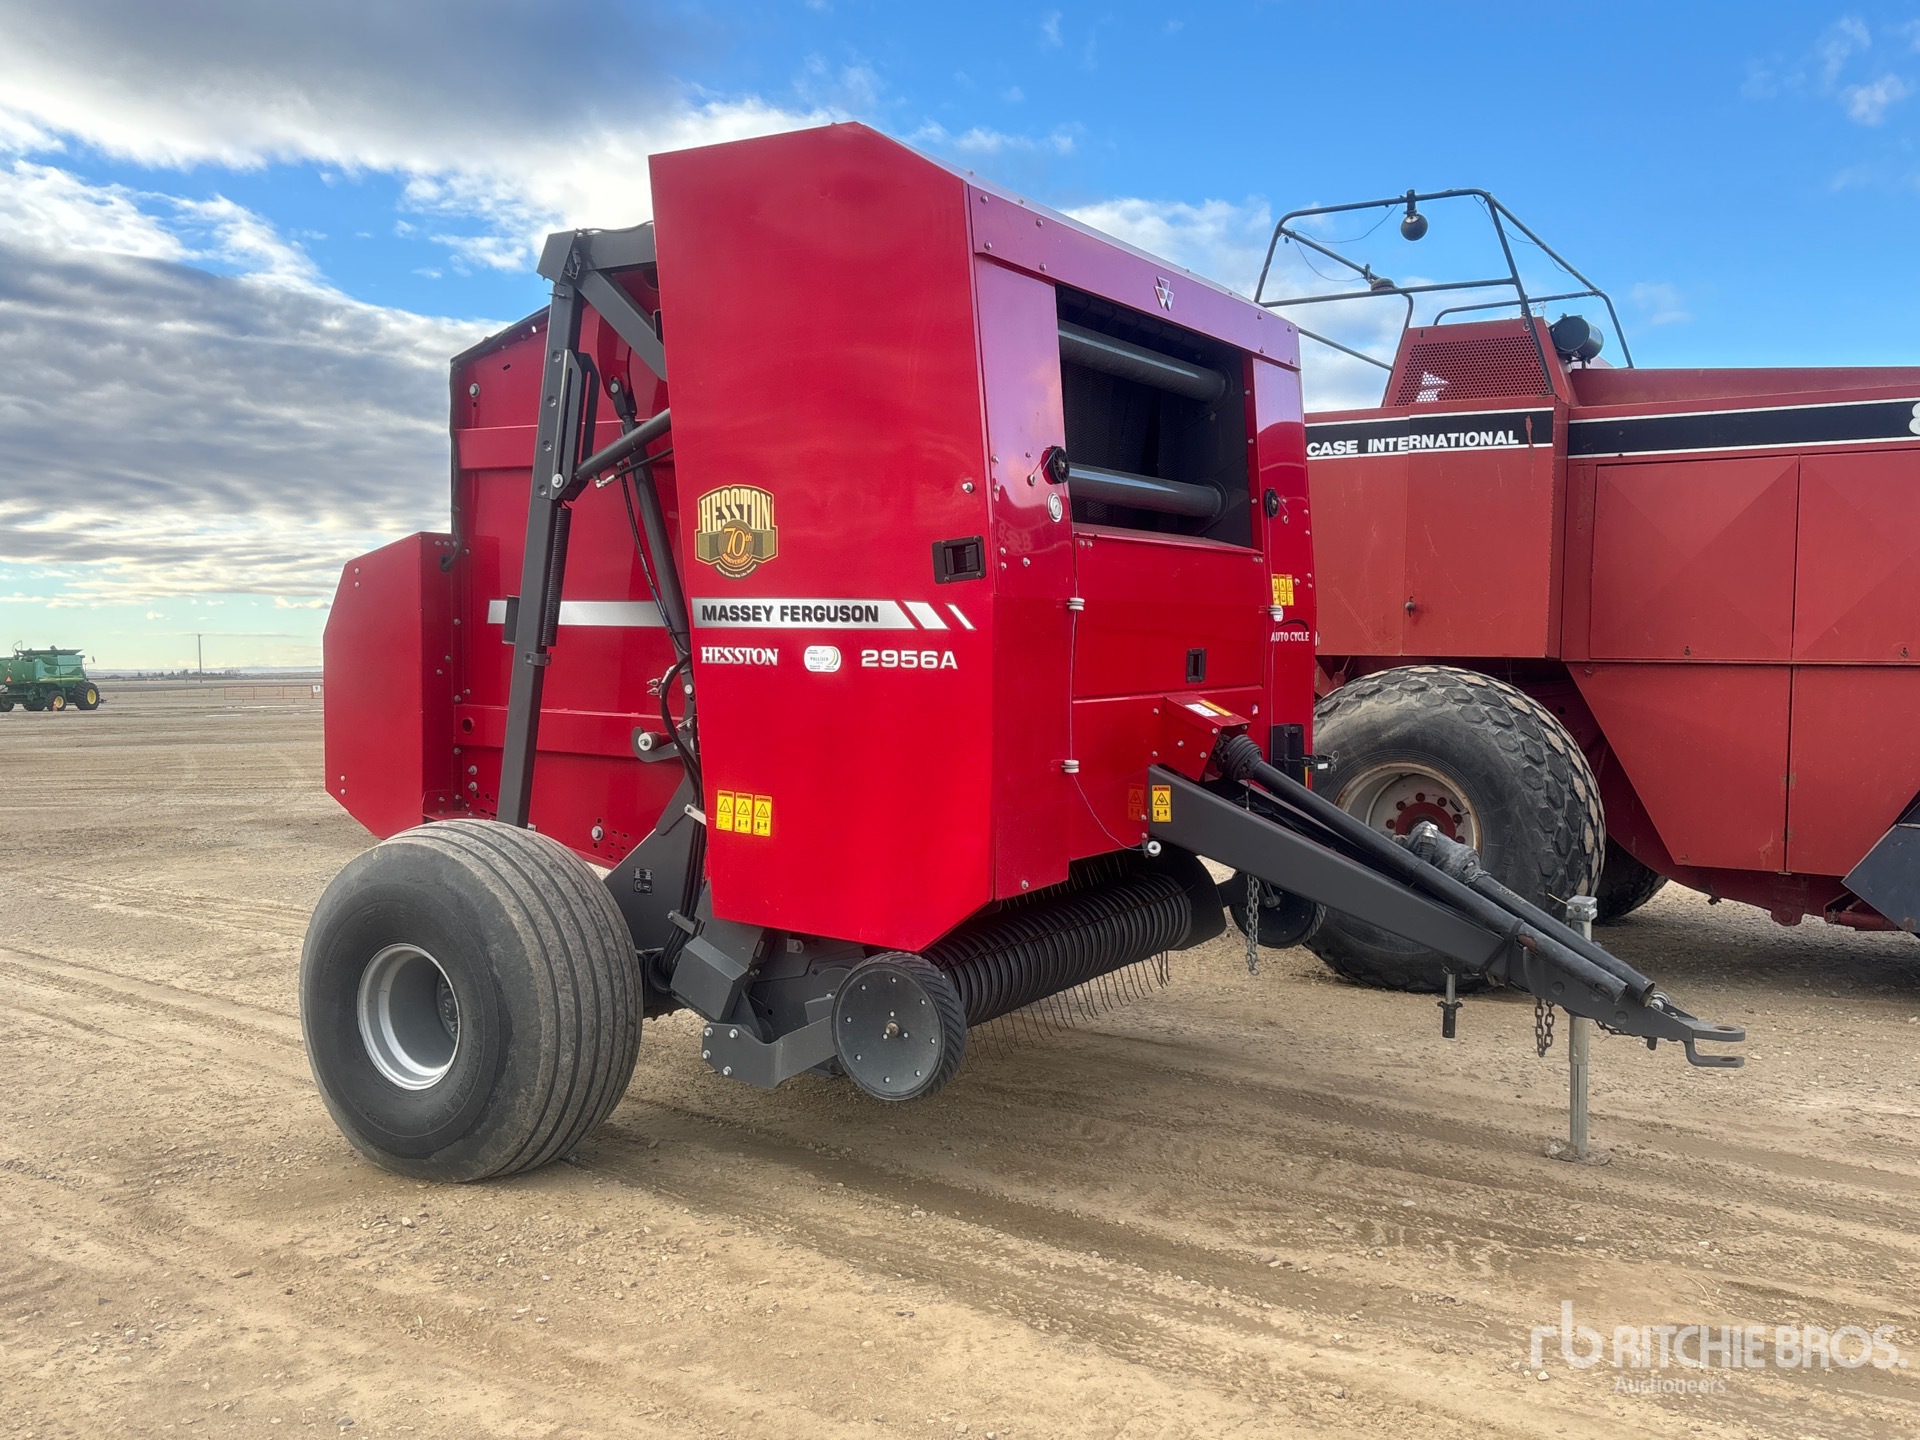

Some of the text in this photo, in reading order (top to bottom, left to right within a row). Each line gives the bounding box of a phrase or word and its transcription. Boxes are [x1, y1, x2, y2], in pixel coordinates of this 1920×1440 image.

[1306, 430, 1519, 456] CASE INTERNATIONAL
[701, 488, 771, 533] HESSTON
[702, 605, 879, 622] MASSEY FERGUSON
[1270, 631, 1310, 642] AUTO CYCLE
[701, 646, 779, 666] HESSTON
[861, 649, 958, 669] 2956A
